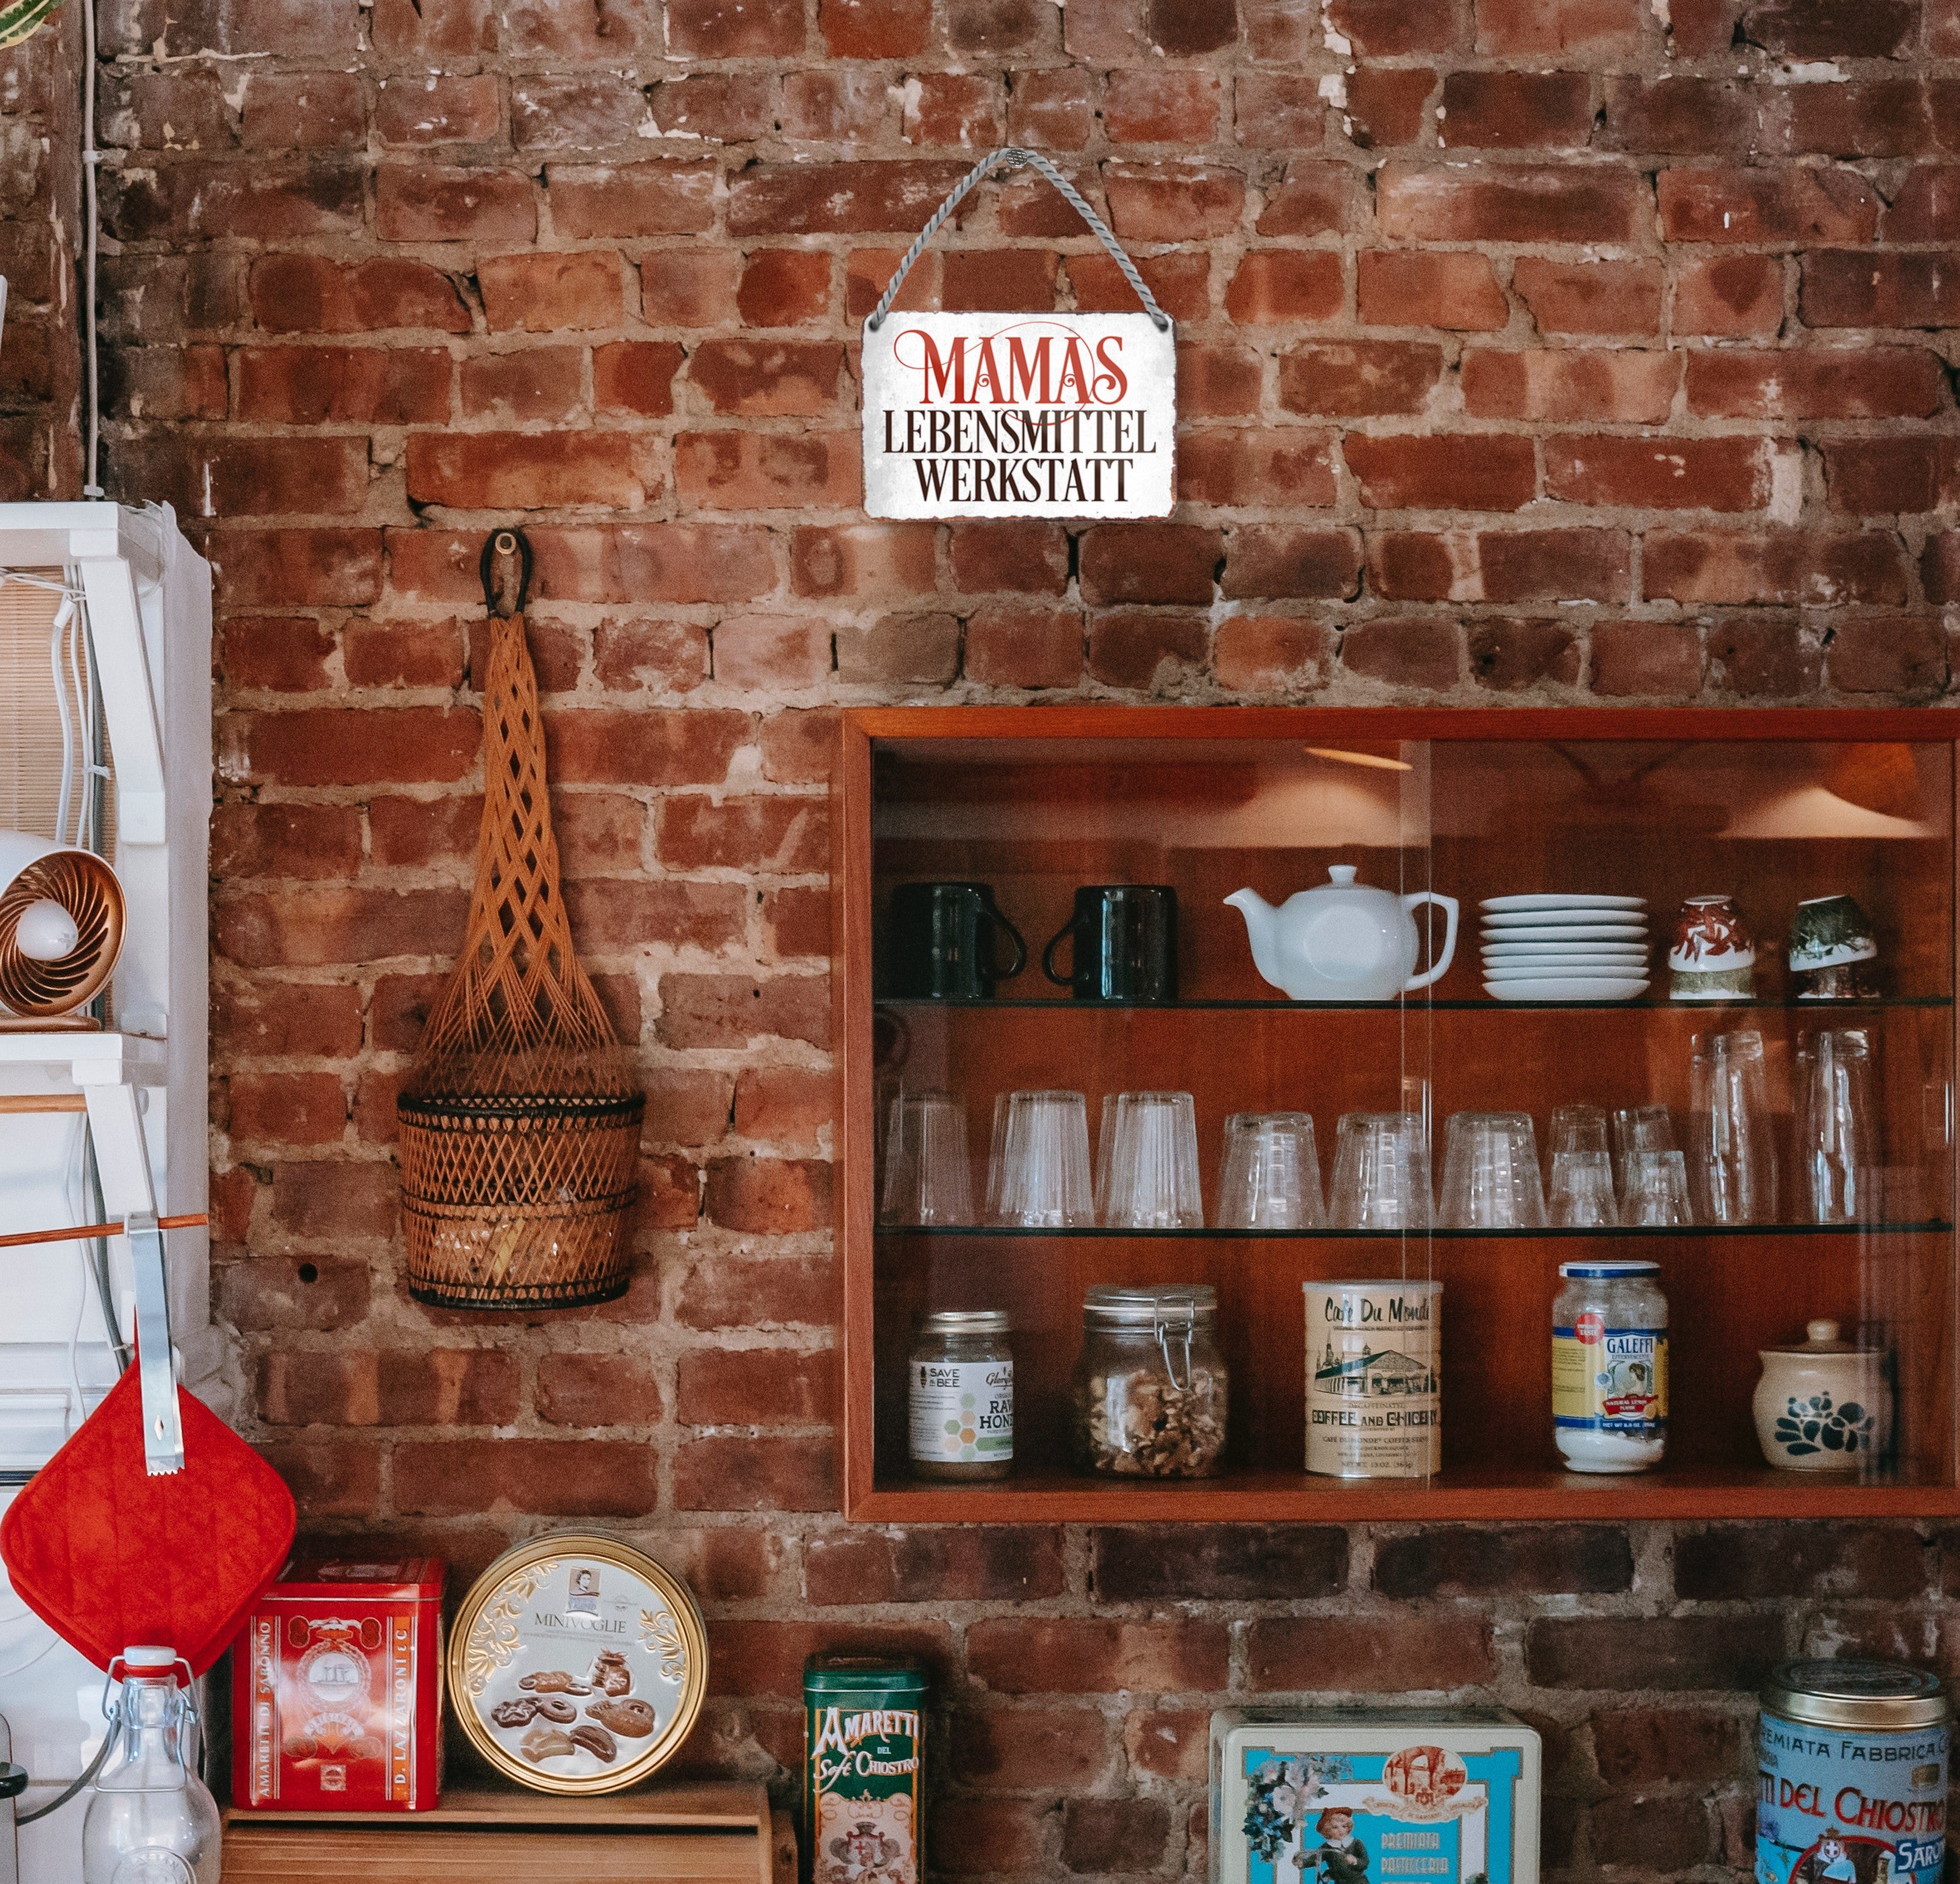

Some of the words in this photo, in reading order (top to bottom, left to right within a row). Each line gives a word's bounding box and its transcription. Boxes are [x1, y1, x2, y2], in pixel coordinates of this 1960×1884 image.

[894, 322, 1128, 405] MAMAS
[882, 409, 1157, 454] LEBENSMITTEL
[913, 457, 1133, 502] WERKSTATT
[1360, 1298, 1383, 1323] Du
[1607, 1338, 1653, 1354] GALEFFI
[930, 1368, 960, 1378] SAVE
[937, 1379, 960, 1387] BEE
[1361, 1416, 1384, 1426] AND
[534, 1612, 627, 1634] MINIVOGLIE
[395, 1659, 407, 1760] LAZZARONI
[811, 1707, 919, 1759] AMARETTI
[1841, 1740, 1935, 1762] FABBRICA
[855, 1751, 920, 1777] CHIOSTRO
[1779, 1777, 1827, 1819] DEL
